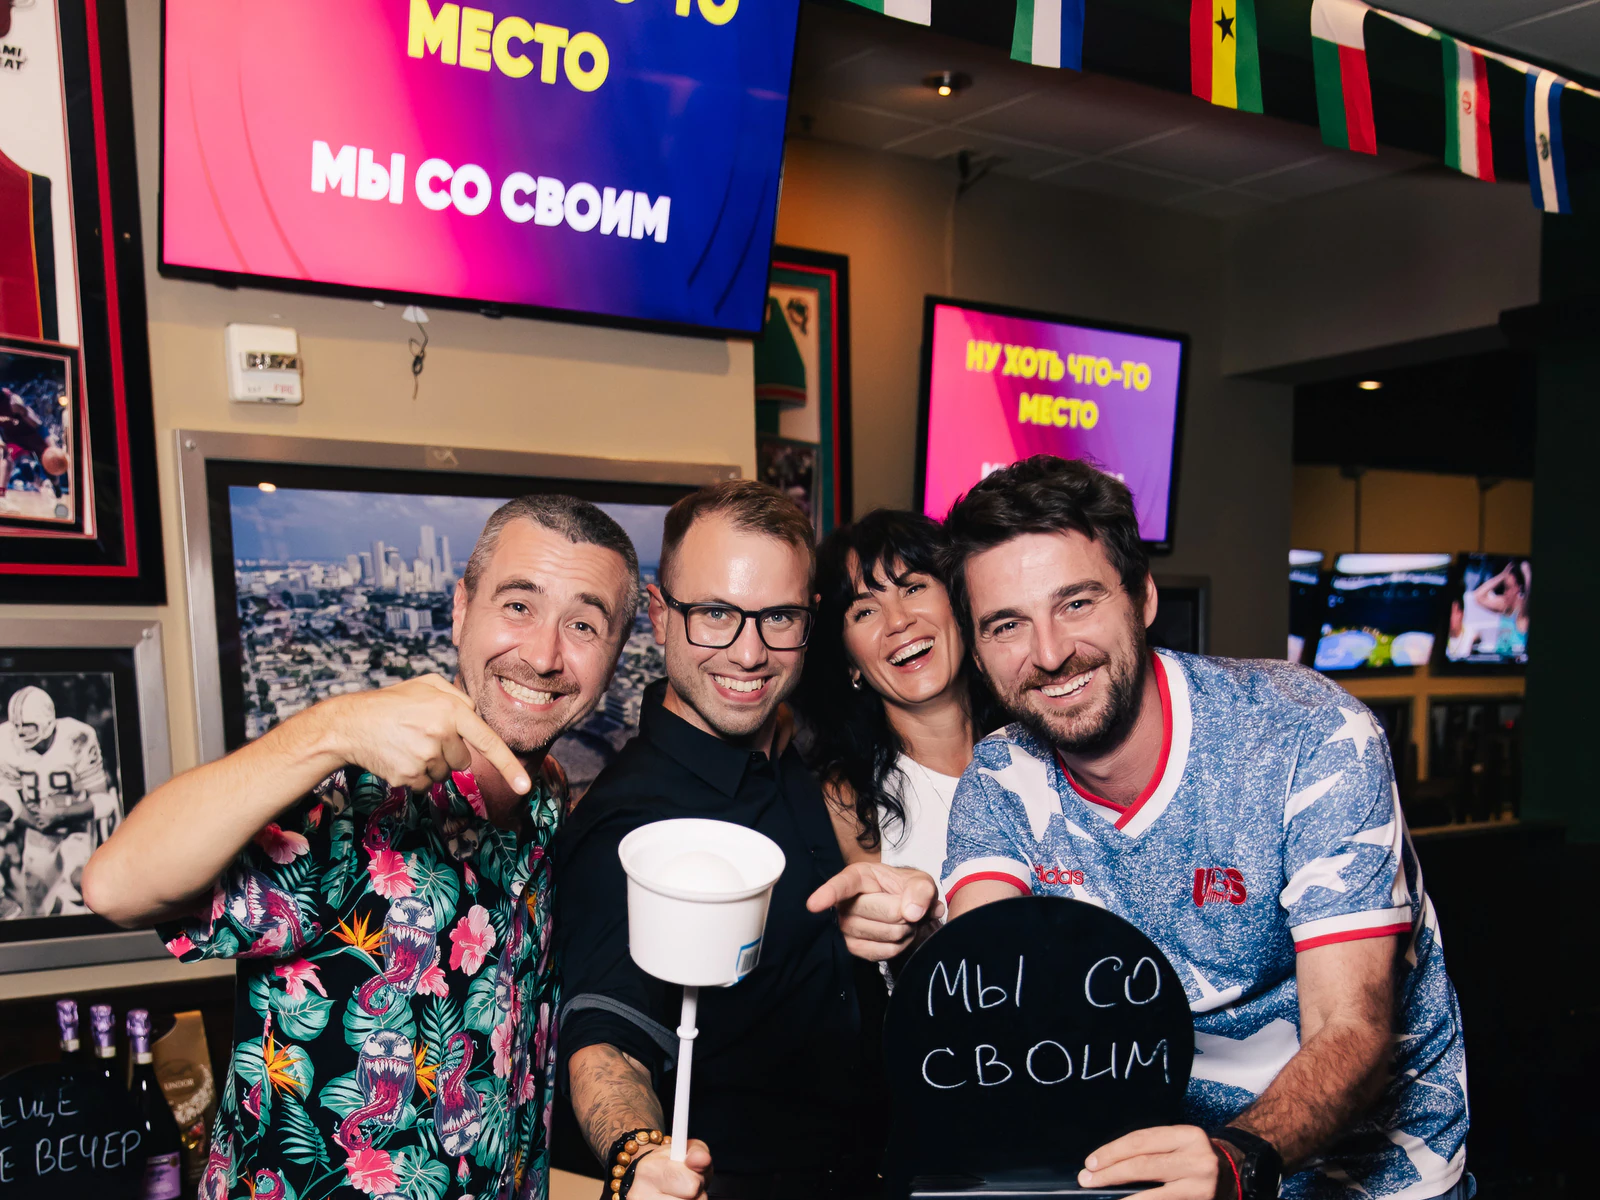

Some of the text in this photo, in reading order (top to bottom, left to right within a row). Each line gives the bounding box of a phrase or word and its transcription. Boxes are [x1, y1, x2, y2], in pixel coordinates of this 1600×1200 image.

[0, 57, 24, 70] AT
[407, 0, 610, 92] МЕСТО
[311, 139, 671, 243] МЫ СО СВОИМ
[966, 340, 1151, 392] НУ ХОТЬ ЧТО-ТО
[1018, 392, 1098, 429] МЕСТО
[17, 770, 74, 804] 39
[927, 955, 1161, 1017] МЫ СО
[921, 1038, 1170, 1089] СВОИМ
[35, 1129, 142, 1177] ВЕЧЕР
